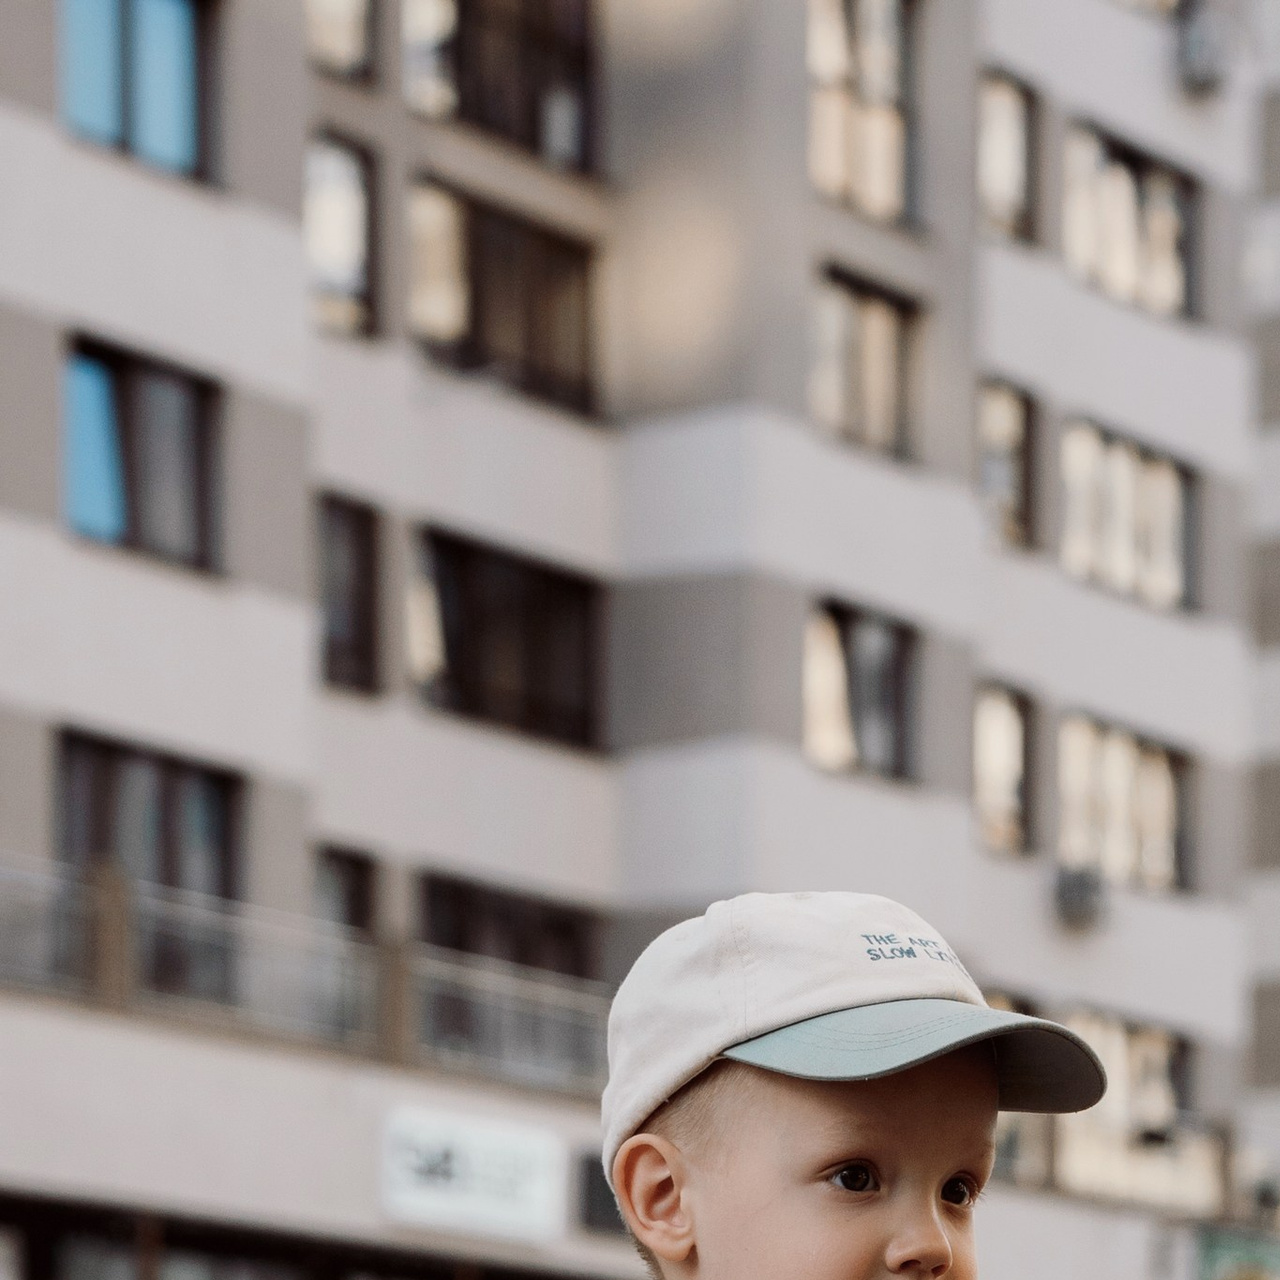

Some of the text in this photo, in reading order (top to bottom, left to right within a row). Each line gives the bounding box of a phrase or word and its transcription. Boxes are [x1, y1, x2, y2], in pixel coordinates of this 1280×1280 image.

[861, 934, 940, 949] THE ART
[867, 946, 917, 961] SLOW
